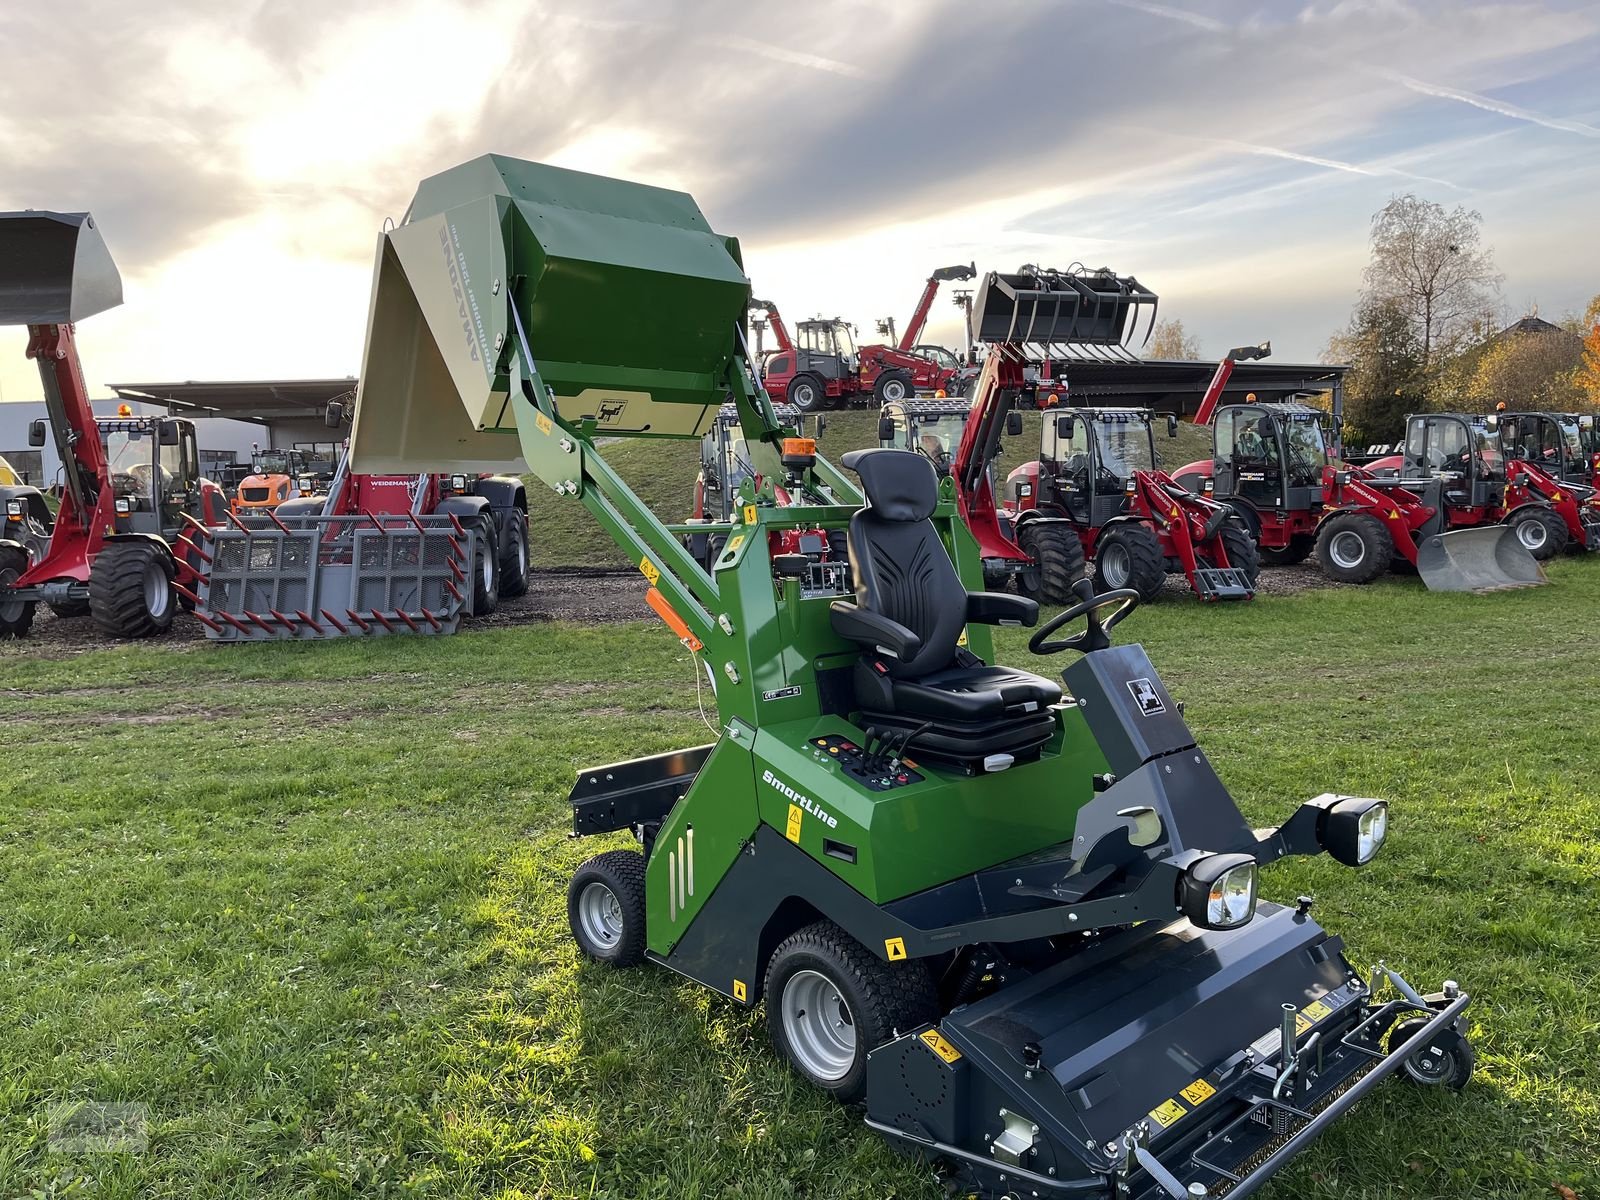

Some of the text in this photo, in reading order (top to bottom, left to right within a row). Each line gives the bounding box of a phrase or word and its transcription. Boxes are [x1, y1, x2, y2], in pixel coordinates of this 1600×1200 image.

[457, 252, 471, 285] 1250
[439, 224, 480, 361] AMAZONE
[1349, 482, 1379, 504] WEIDEMANN
[762, 769, 838, 829] SmartLine
